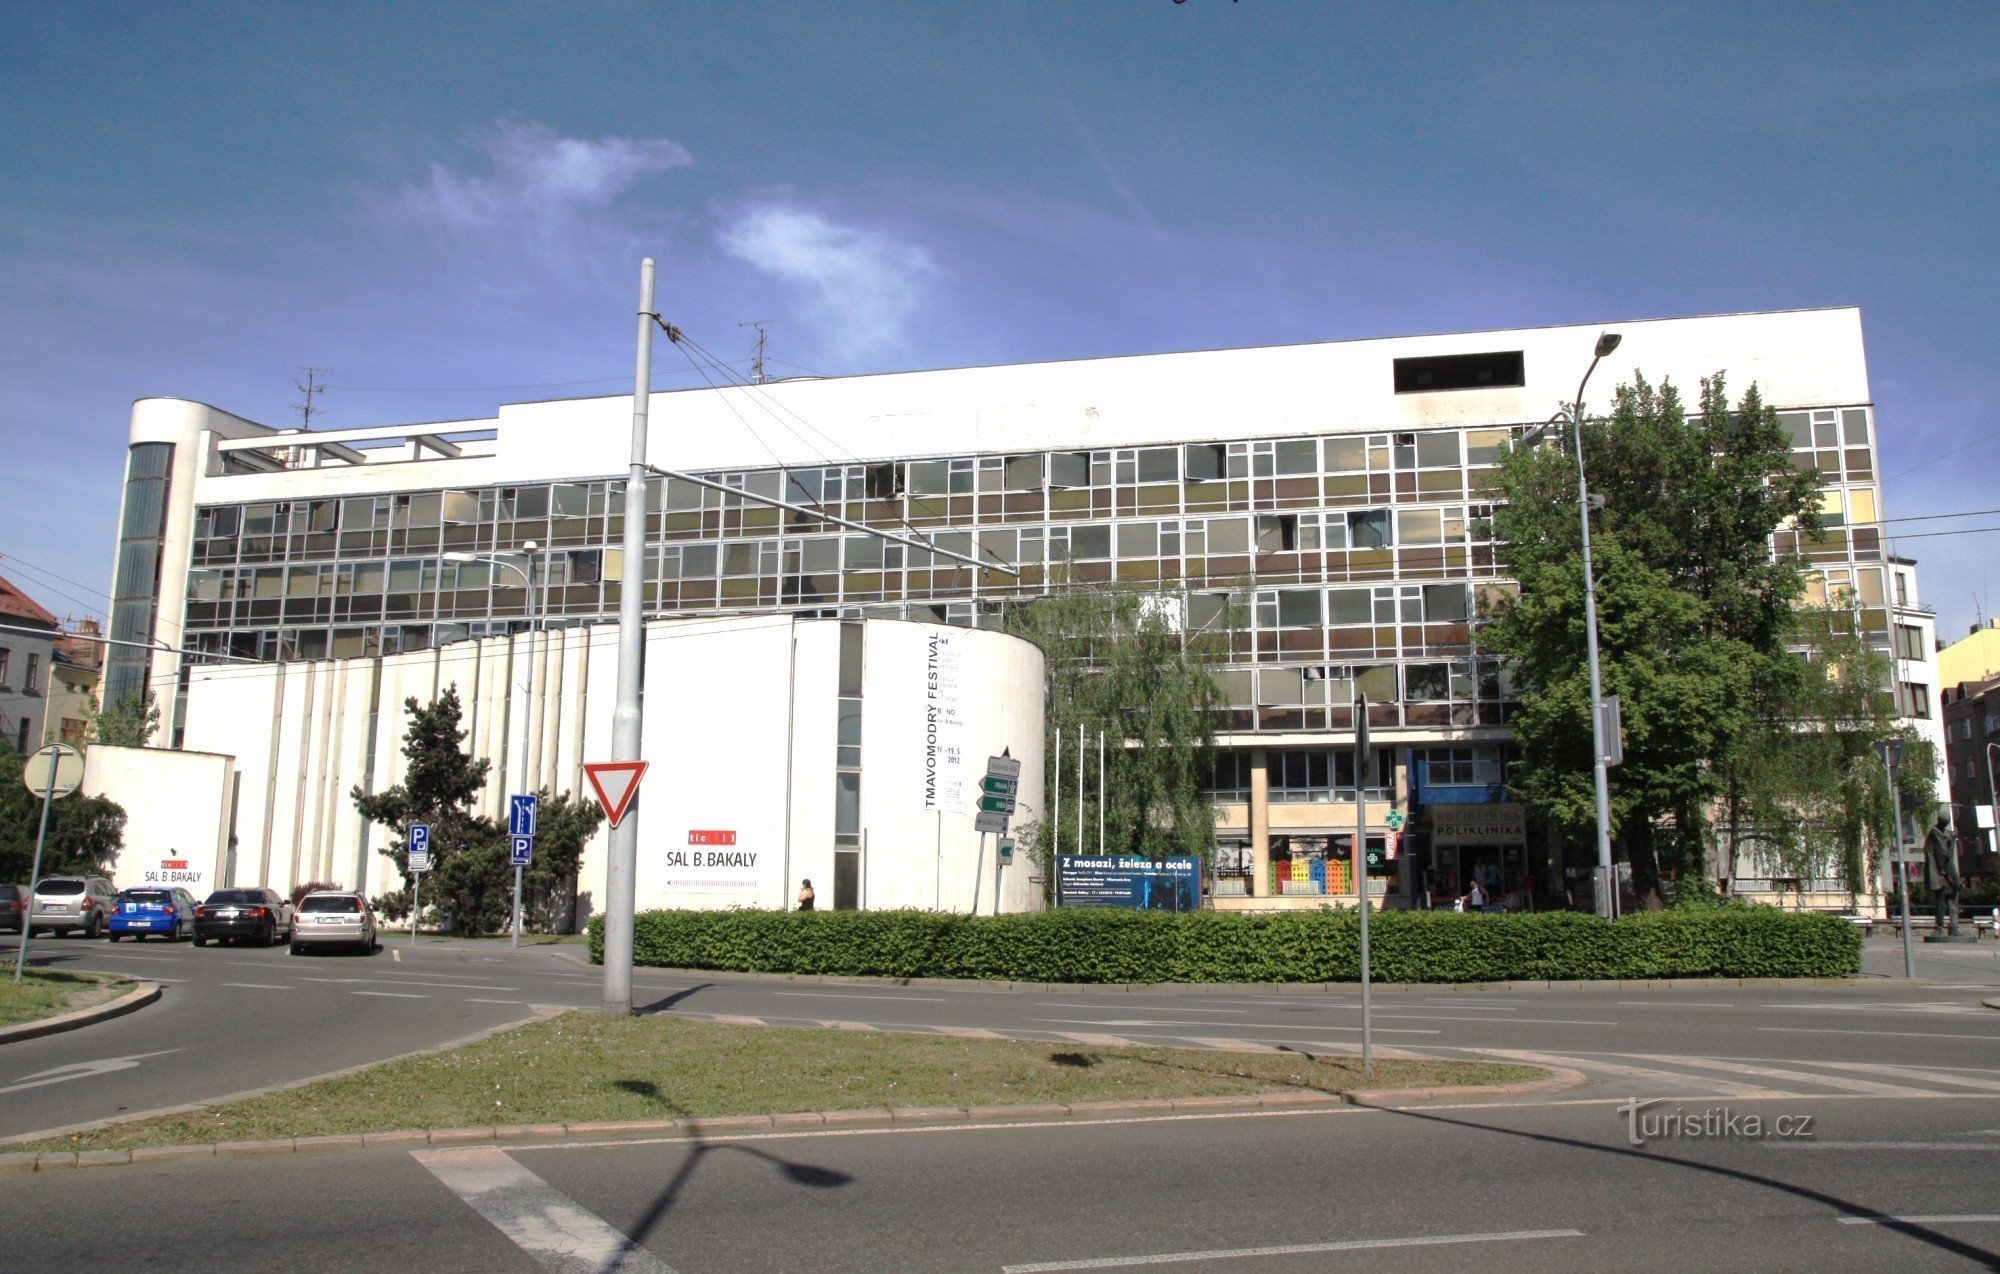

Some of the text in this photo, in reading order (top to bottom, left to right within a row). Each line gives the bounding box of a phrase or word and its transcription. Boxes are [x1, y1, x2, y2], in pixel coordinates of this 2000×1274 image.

[928, 632, 939, 699] FESTIVAL
[948, 756, 960, 764] 2012
[413, 828, 425, 844] P
[1437, 827, 1522, 835] POLIKLINIKA
[516, 839, 528, 856] P
[1387, 833, 1395, 859] OPTIKA
[1063, 857, 1192, 870] Z mosazi, železa a ocele
